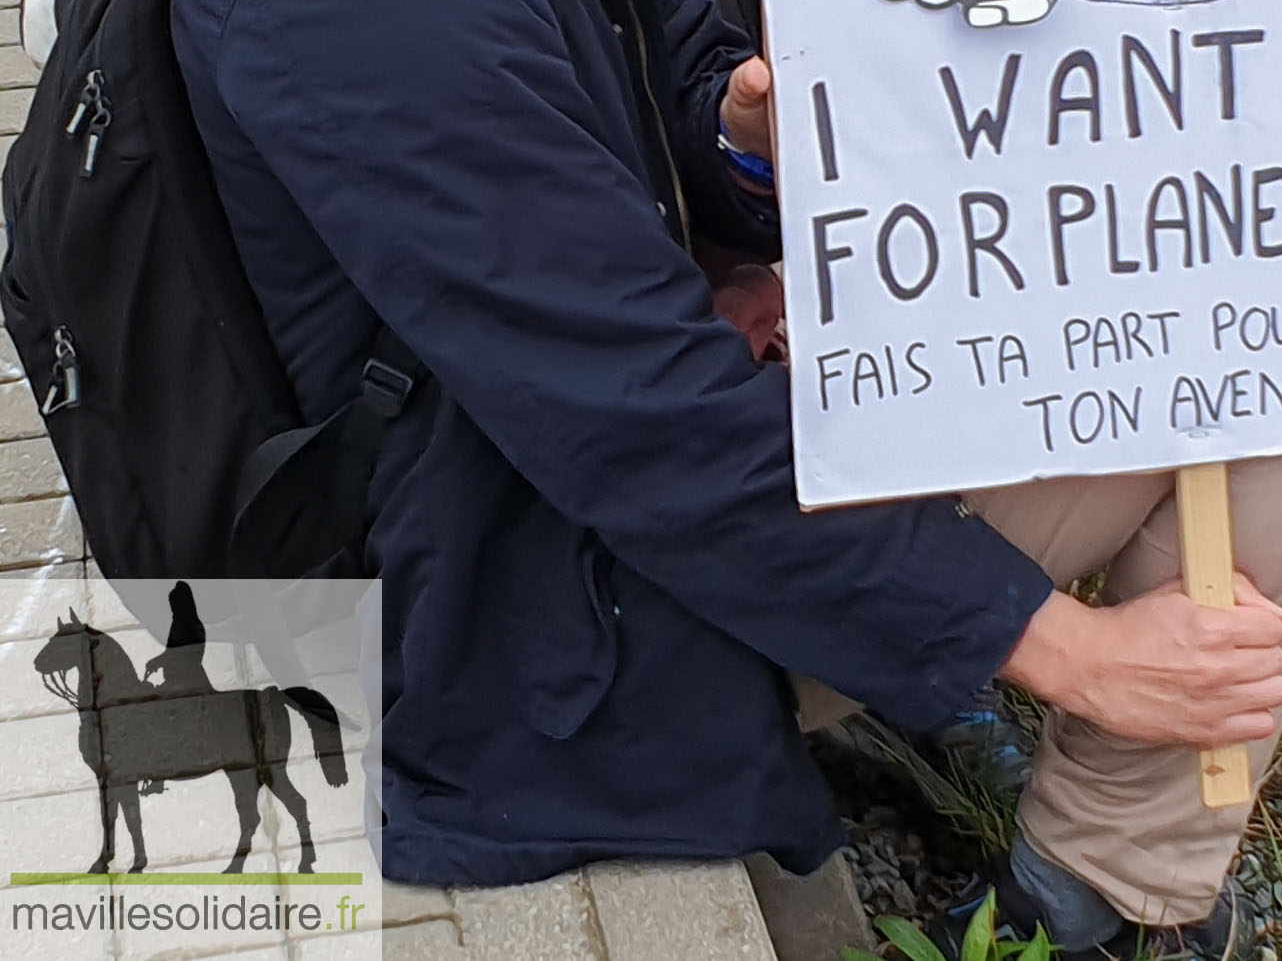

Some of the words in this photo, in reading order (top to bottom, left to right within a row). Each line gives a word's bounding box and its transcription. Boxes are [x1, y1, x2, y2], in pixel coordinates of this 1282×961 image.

[811, 80, 840, 183] I
[938, 28, 1266, 161] WANT
[811, 191, 1026, 327] FOR
[815, 341, 933, 412] FAIS
[955, 334, 1030, 387] TA
[1062, 310, 1182, 374] PART
[1022, 385, 1143, 452] TON
